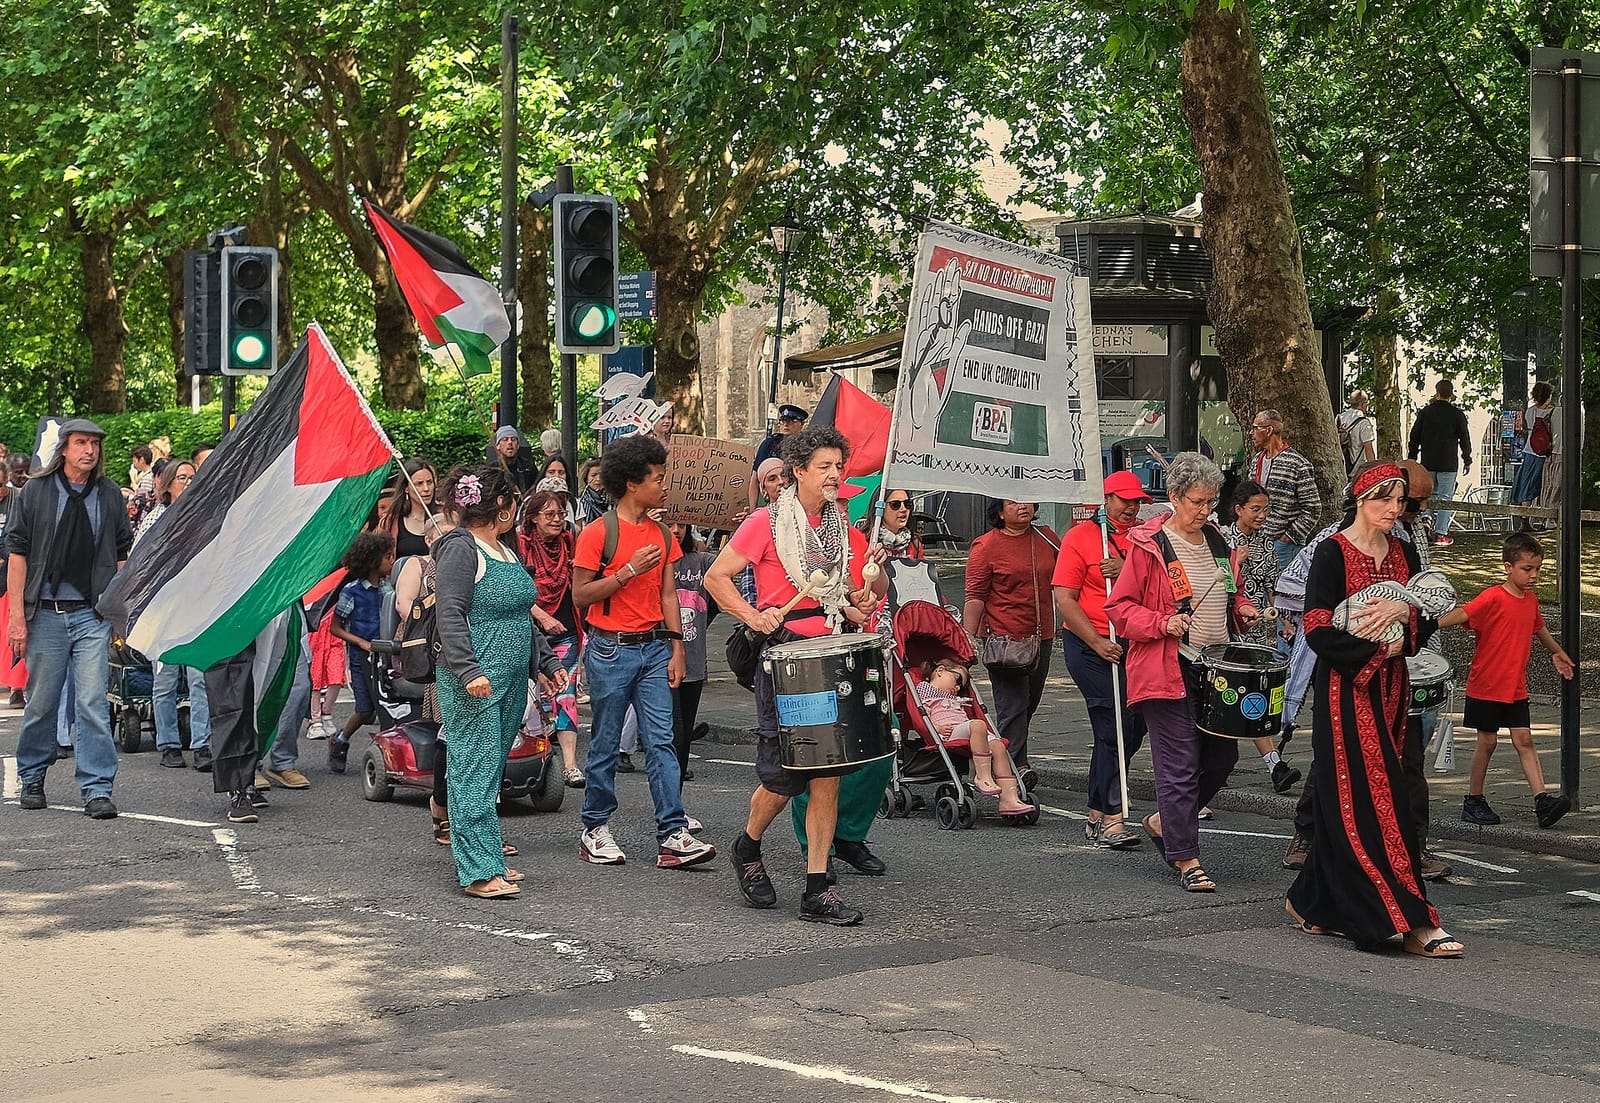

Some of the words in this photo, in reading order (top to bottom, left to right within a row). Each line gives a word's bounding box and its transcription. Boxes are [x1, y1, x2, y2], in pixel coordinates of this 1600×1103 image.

[977, 263, 990, 281] NO
[989, 266, 1001, 285] TO
[972, 308, 1004, 336] HANDS
[1006, 315, 1023, 340] OFF
[1024, 319, 1046, 345] GAZA
[1092, 326, 1134, 336] EDNA'S
[962, 358, 980, 380] END
[981, 362, 994, 383] UK
[994, 365, 1041, 391] COMPLICITY
[981, 407, 1008, 433] BPA
